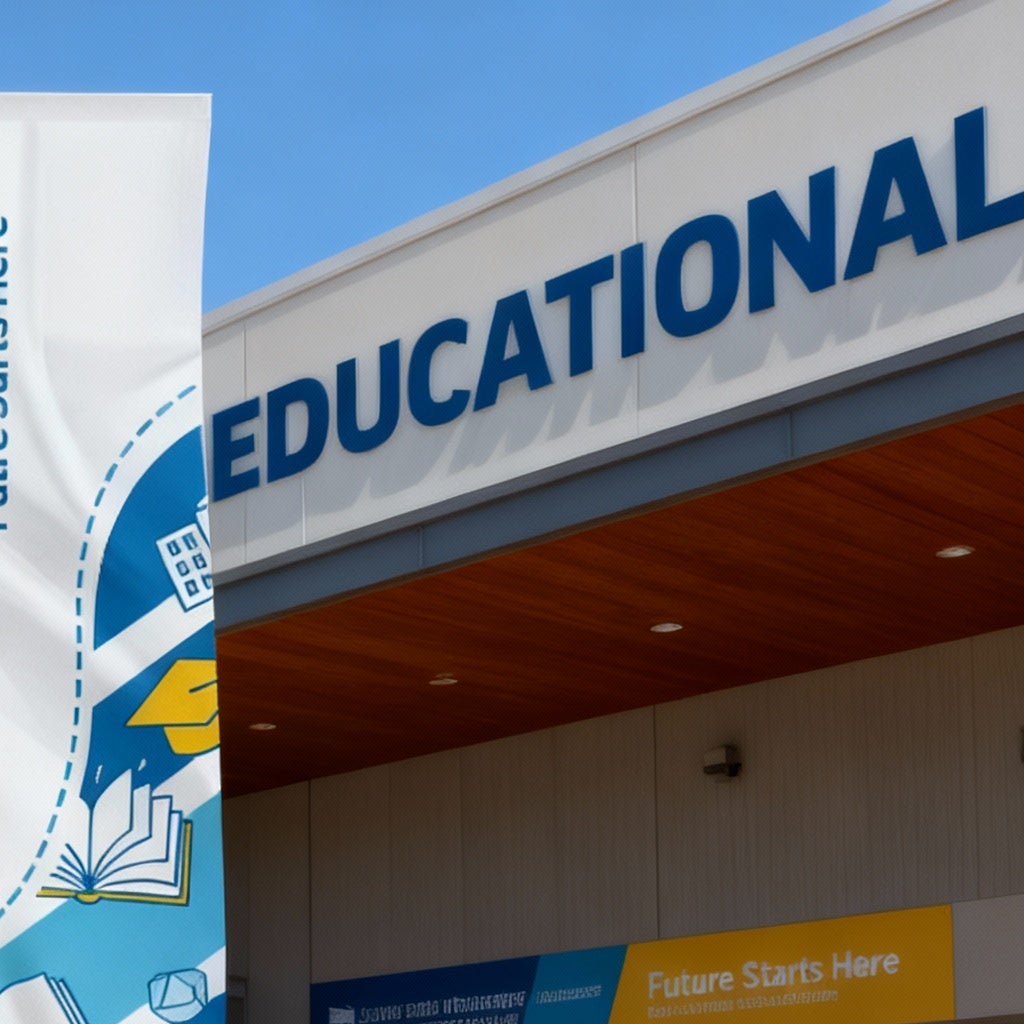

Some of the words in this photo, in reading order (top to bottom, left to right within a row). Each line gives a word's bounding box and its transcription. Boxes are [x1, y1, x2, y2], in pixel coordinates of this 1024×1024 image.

[213, 106, 1024, 502] EDUCATIONAL
[647, 970, 735, 1000] Future
[742, 957, 824, 989] Starts
[832, 949, 901, 980] Here
